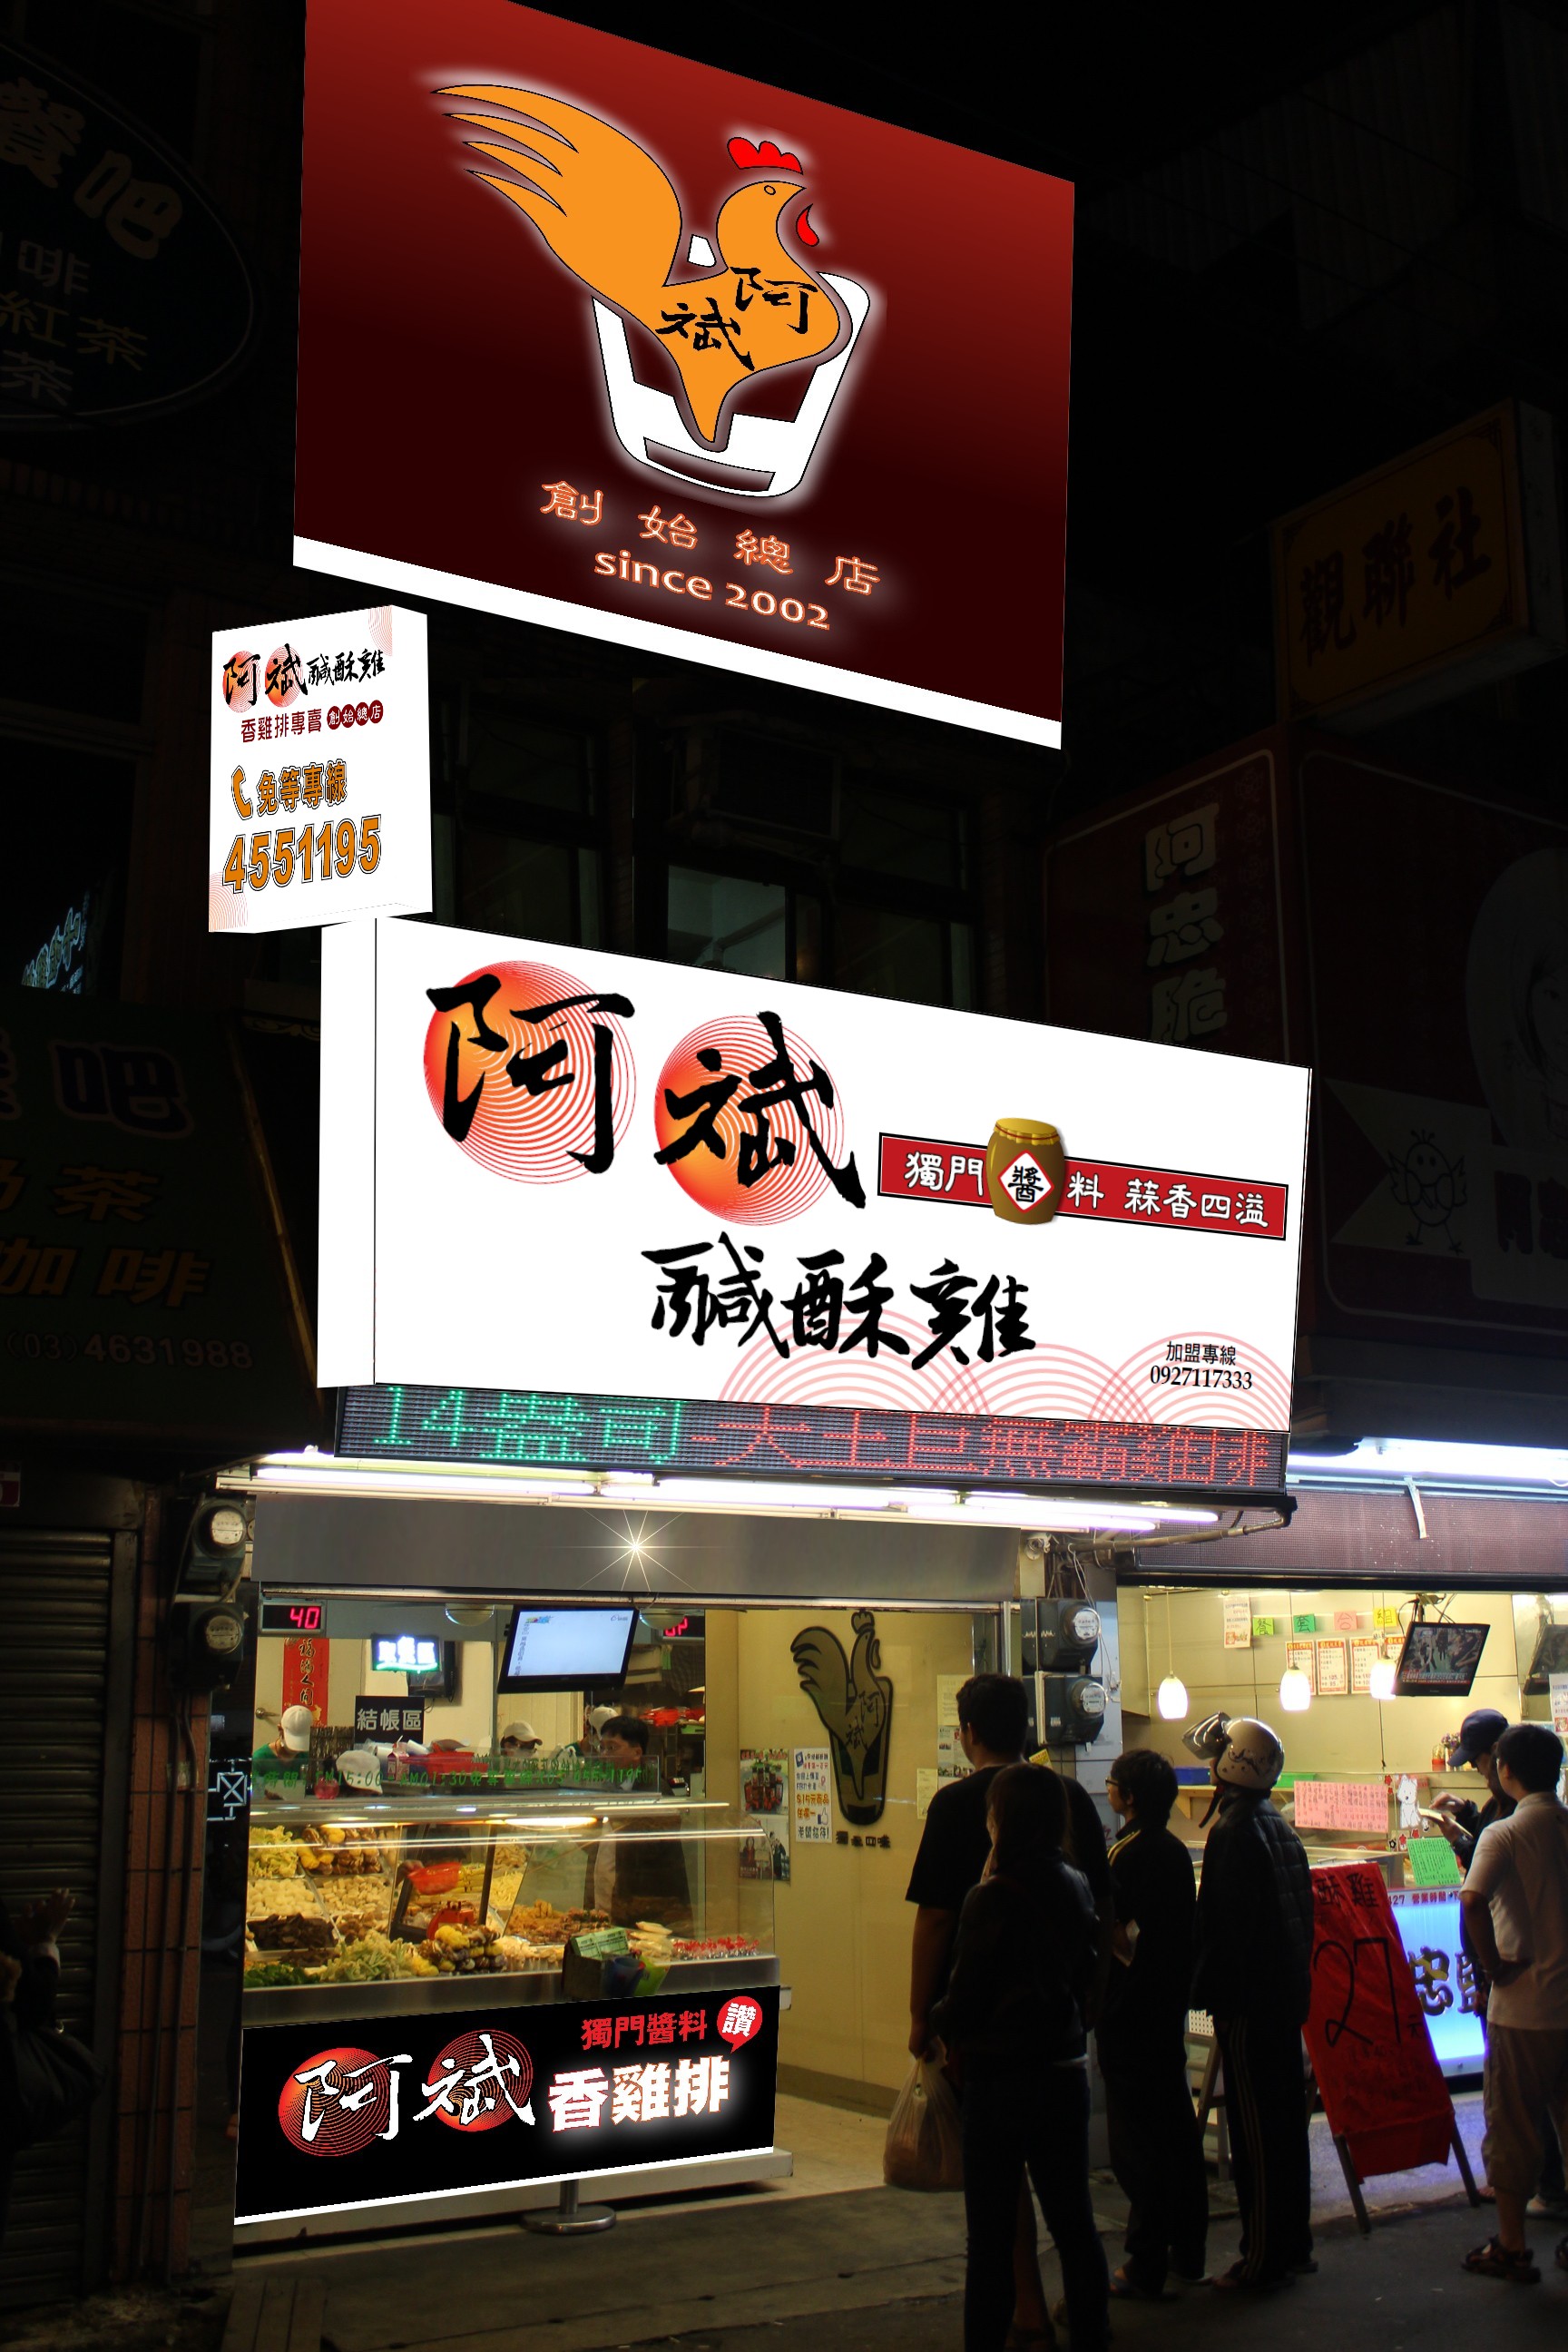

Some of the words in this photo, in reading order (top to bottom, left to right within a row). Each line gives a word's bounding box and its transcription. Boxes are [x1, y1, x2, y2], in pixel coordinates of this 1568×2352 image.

[0, 231, 90, 296] 啡
[540, 479, 880, 597] 創始總店
[594, 548, 712, 601] since
[724, 581, 831, 632] 2002
[240, 708, 322, 743] 香雞排專賣
[328, 703, 383, 727] 創始總店
[256, 759, 348, 818] 免等專線
[222, 814, 382, 894] 4551195
[426, 973, 867, 1209] 阿斌
[1124, 1178, 1270, 1229] 蒜香四溢
[641, 1230, 1036, 1370] 鹹酥雞
[1149, 1364, 1253, 1391] 0927117333
[1165, 1341, 1237, 1367] 加盟專線
[290, 1607, 320, 1630] 40
[356, 1709, 423, 1731] 結帳區
[581, 2009, 708, 2051] 獨門醬料
[546, 2054, 730, 2132] 香雞排
